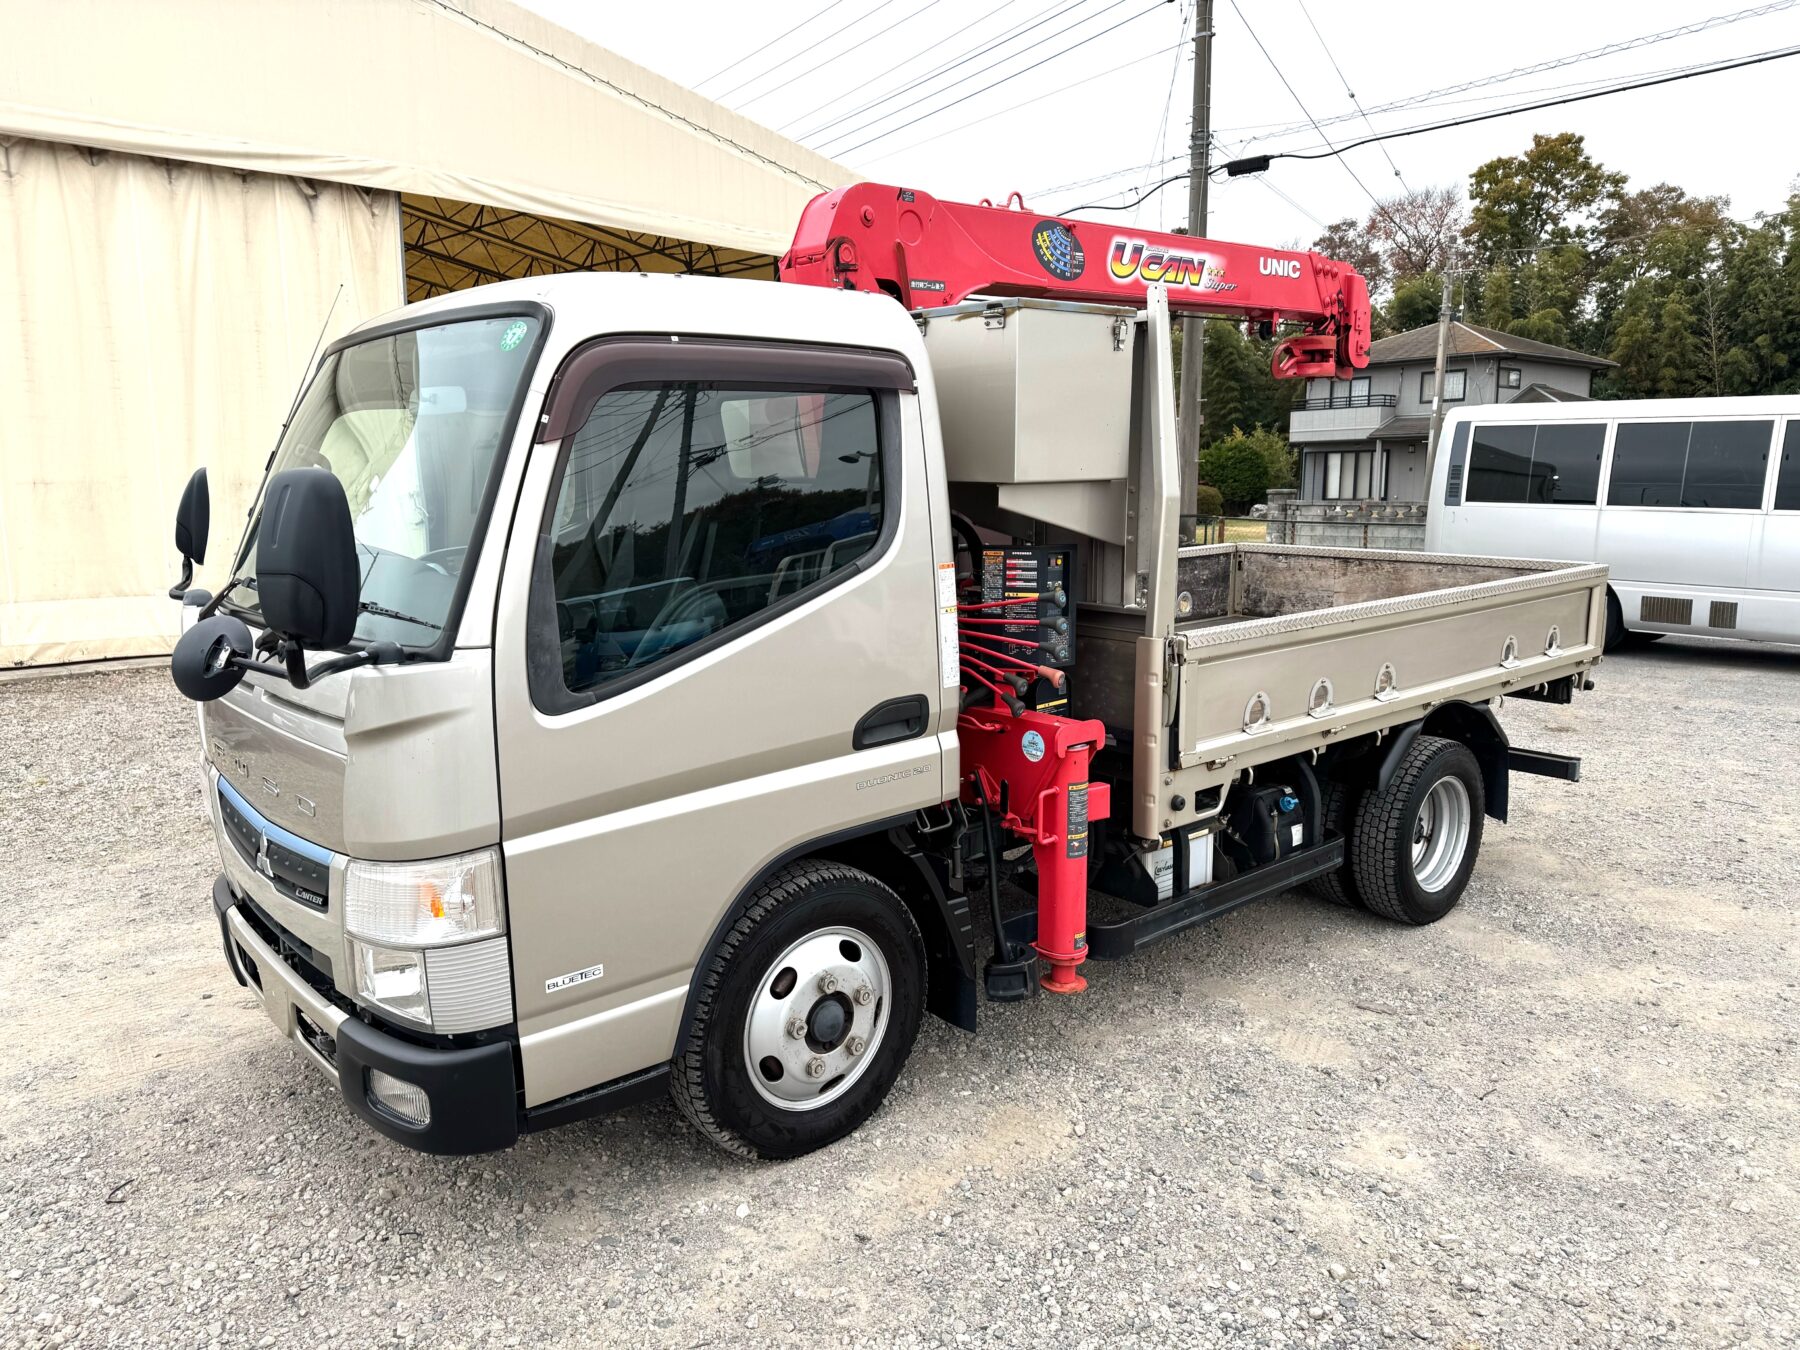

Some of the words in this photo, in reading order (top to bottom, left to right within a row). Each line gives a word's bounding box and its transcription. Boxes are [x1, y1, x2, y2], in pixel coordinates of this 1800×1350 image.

[1259, 256, 1302, 279] UNIC
[1205, 276, 1238, 293] Super
[214, 742, 316, 817] FUSO
[856, 769, 911, 791] DUONIC
